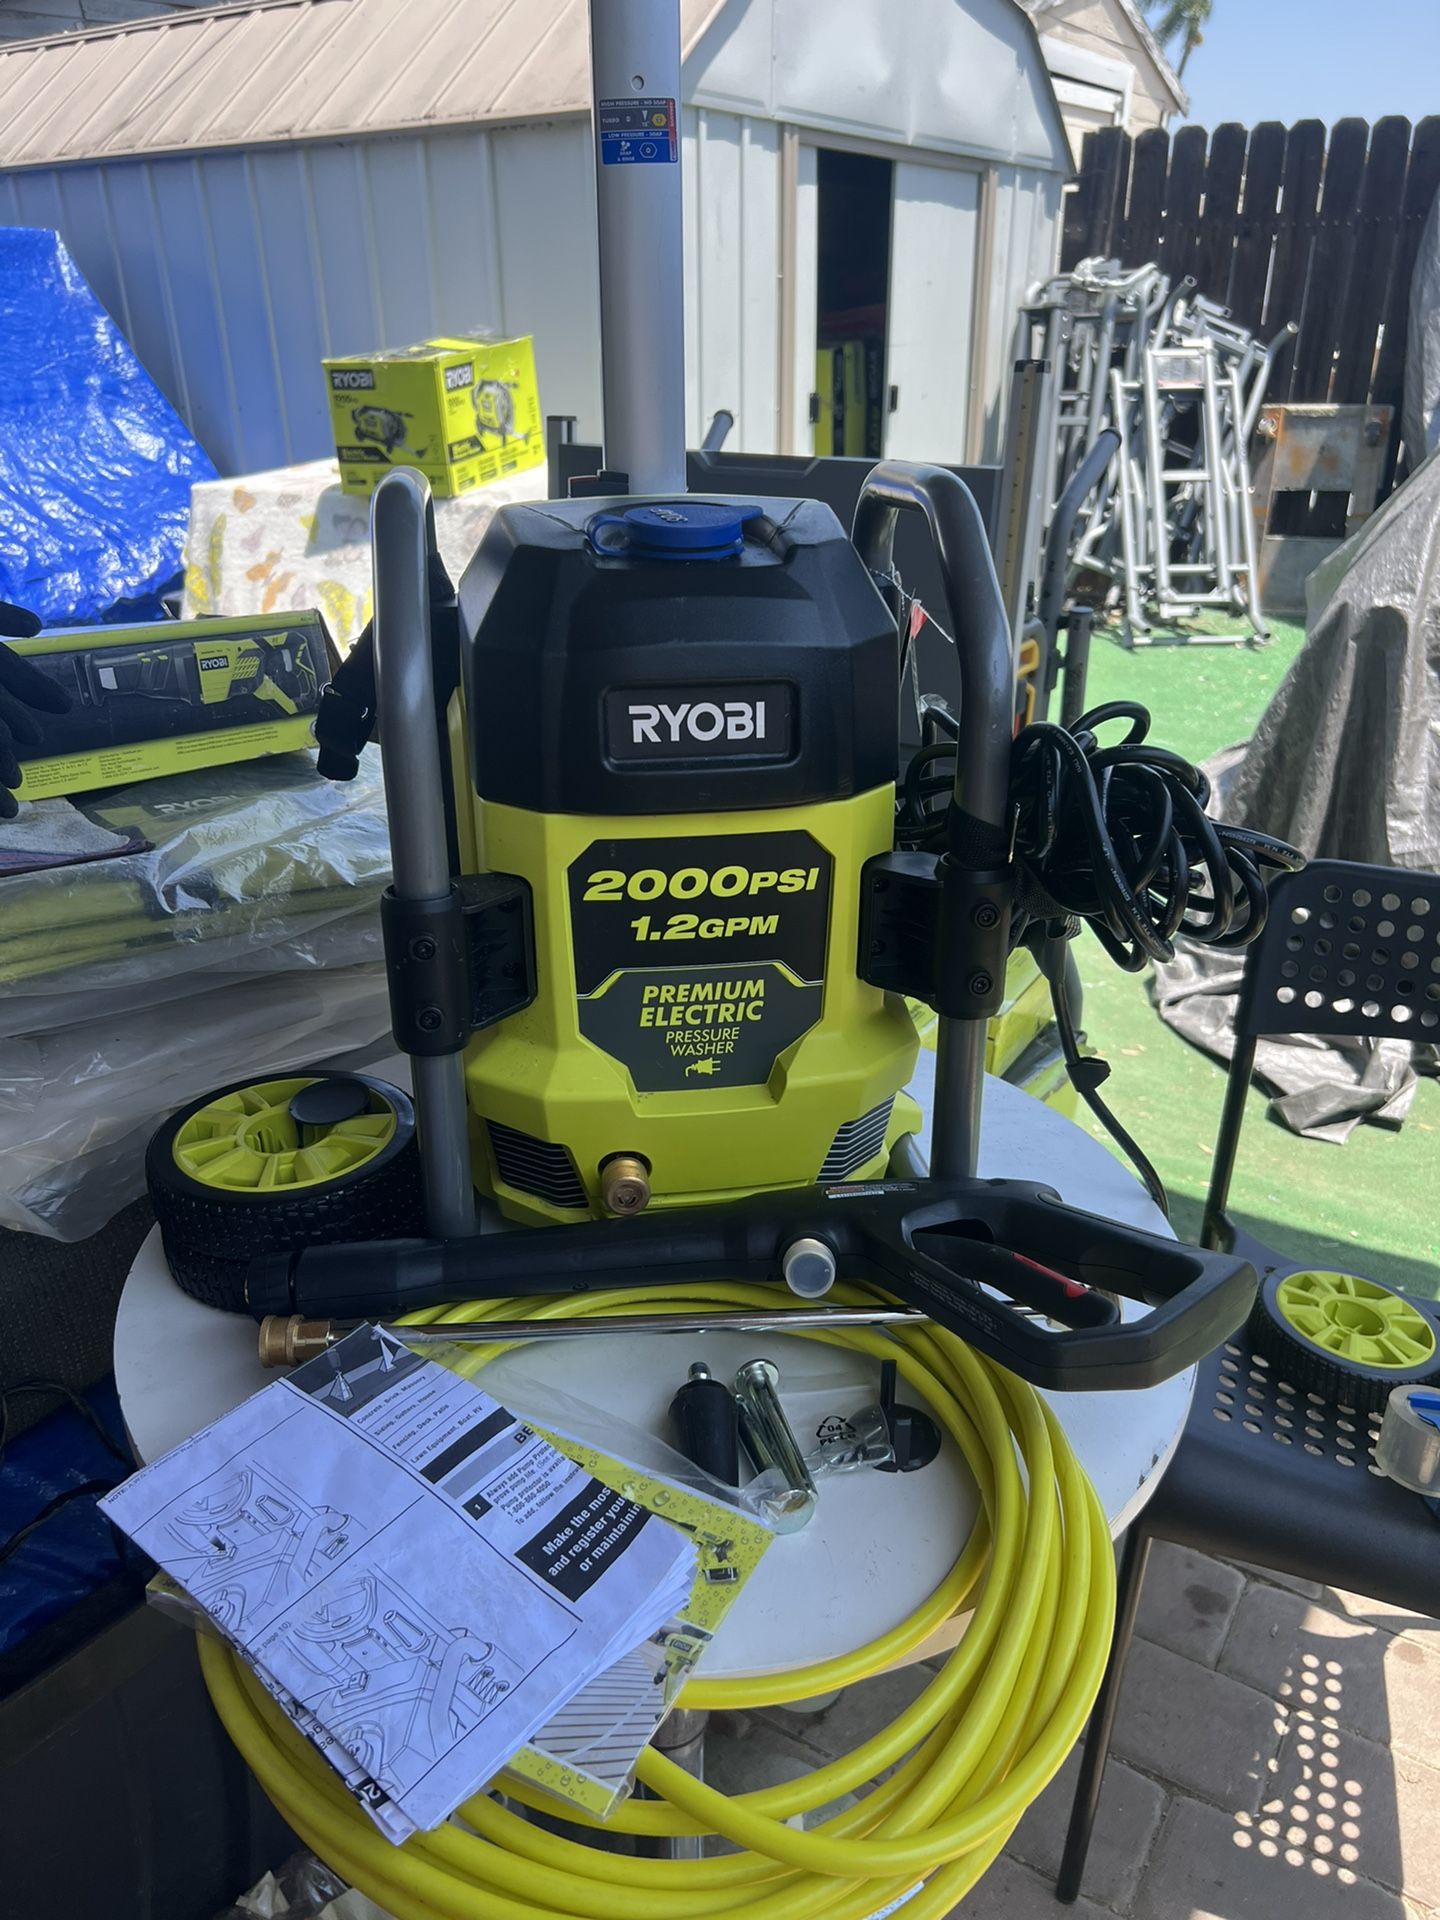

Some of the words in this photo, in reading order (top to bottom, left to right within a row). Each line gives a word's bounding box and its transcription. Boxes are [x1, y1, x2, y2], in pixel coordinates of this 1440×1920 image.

[332, 372, 373, 389] RYOBI
[446, 365, 473, 390] RYOBI
[201, 657, 228, 670] RYOBI
[628, 701, 766, 743] RYOBI
[583, 865, 819, 901] 2000PSI
[630, 914, 779, 942] 1.2GPM
[643, 979, 765, 1004] PREMIUM
[640, 1000, 764, 1027] ELECTRIC
[665, 1027, 739, 1043] PRESSURE
[670, 1041, 734, 1056] WASHER
[401, 1375, 426, 1392] Masonry
[417, 1389, 436, 1404] House
[433, 1404, 450, 1417] Patio
[513, 1425, 534, 1444] BE
[827, 1424, 842, 1432] 04
[410, 1446, 428, 1464] Lawn
[486, 1478, 509, 1498] Always
[507, 1471, 519, 1482] add
[517, 1459, 535, 1475] Pump
[509, 1478, 527, 1492] pump
[500, 1495, 519, 1511] Pump
[517, 1478, 544, 1499] protector
[515, 1517, 525, 1526] To
[536, 1491, 555, 1510] follow
[552, 1481, 564, 1494] the
[542, 1527, 574, 1556] Make
[570, 1509, 591, 1528] the
[588, 1486, 611, 1511] mos
[548, 1554, 570, 1576] and
[568, 1517, 608, 1557] register
[579, 1557, 593, 1572] or
[591, 1503, 642, 1560] maintainin
[262, 1631, 279, 1649] page
